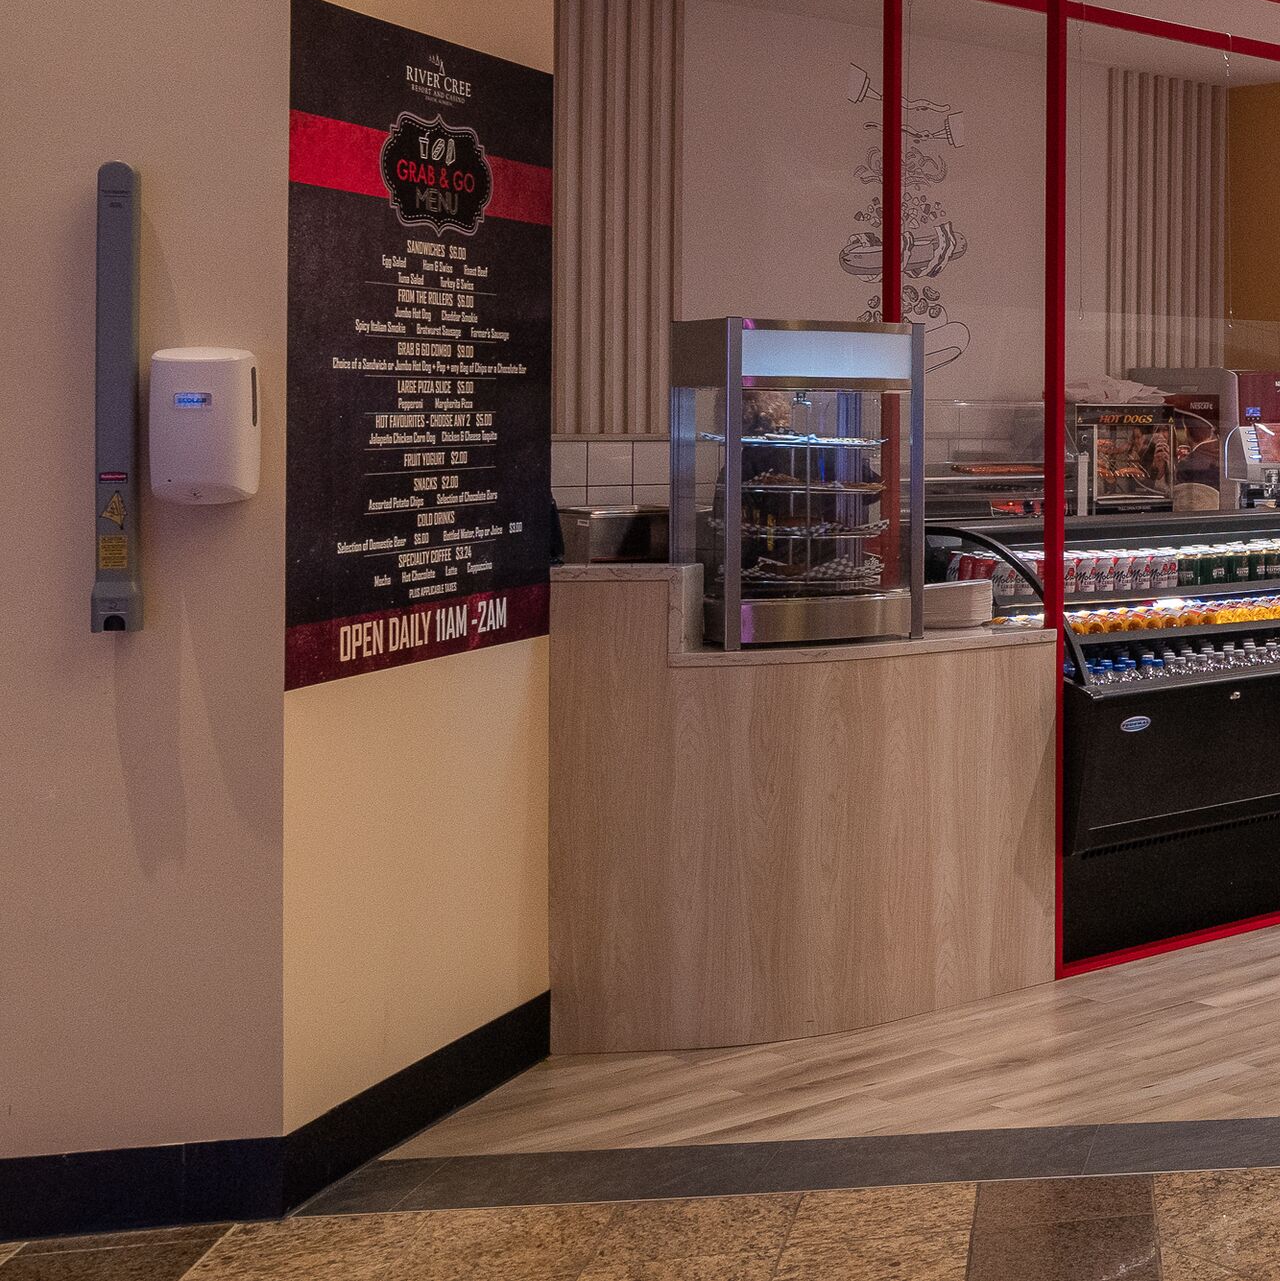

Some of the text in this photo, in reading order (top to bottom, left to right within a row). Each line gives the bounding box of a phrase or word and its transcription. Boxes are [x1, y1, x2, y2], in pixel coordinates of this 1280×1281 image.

[406, 65, 472, 98] RIVER CREE
[396, 158, 475, 193] GRAB & GO
[415, 187, 458, 215] MENU
[406, 240, 446, 258] SANDWICHES
[382, 254, 392, 269] Egg
[392, 255, 407, 268] Salad
[423, 259, 434, 271] Ham
[439, 261, 453, 274] Swiss
[398, 272, 410, 284] Tuna
[410, 273, 425, 286] Salad
[440, 276, 455, 291] Turkey
[460, 279, 474, 291] Swiss
[397, 288, 415, 303] FROM
[416, 290, 428, 305] THE
[428, 291, 454, 307] ROLLERS
[394, 306, 411, 318] Jumbo
[412, 307, 421, 319] Hot
[421, 308, 432, 322] Dog
[441, 310, 461, 322] Cheddar
[355, 318, 510, 341] Spicy Italian Smokie Bratwurst Sausage Farmer's Sausage
[397, 342, 414, 356] GRAB
[421, 343, 430, 356] GO
[430, 343, 452, 358] COMBO
[332, 357, 351, 369] Choice
[351, 357, 358, 369] of
[362, 358, 387, 370] Sandwich
[387, 362, 394, 370] or
[394, 359, 412, 371] Jumbo
[412, 360, 421, 371] Hot
[421, 360, 432, 373] Dog
[436, 361, 446, 374] Pop
[474, 362, 488, 375] Chips
[397, 380, 417, 394] LARGE
[417, 380, 435, 394] PIZZA
[435, 381, 451, 394] SLICE
[397, 397, 473, 411] Pepperoni Margherita Pizza
[375, 414, 389, 429] HOT
[389, 414, 425, 428] FAVOURITES
[430, 414, 453, 427] CHOOSE
[453, 414, 466, 427] ANY
[466, 414, 471, 427] 2
[1100, 414, 1154, 424] HOT DOGS
[393, 432, 413, 444] Chicken
[413, 431, 426, 443] Corn
[426, 431, 436, 445] Dog
[441, 431, 460, 442] Chicken
[464, 430, 481, 442] Cheese
[403, 451, 468, 467] FRUIT YOGURT $2.00
[413, 475, 459, 492] SNACKS $2.00
[368, 489, 498, 511] Assorted Potato Chips Selection of Chocolate Bars
[417, 510, 456, 527] COLD DRINKS
[337, 541, 362, 555] Selection
[362, 539, 369, 551] of
[368, 537, 393, 551] Domestic
[393, 535, 407, 548] Beer
[443, 529, 460, 542] Bottled
[475, 526, 484, 539] Pop
[484, 528, 491, 536] or
[490, 524, 503, 536] Juice
[398, 545, 473, 568] SPECIALTY COFFEE $3.24
[374, 574, 392, 588] Mocha
[401, 571, 411, 583] Hot
[411, 568, 436, 582] Chocolate
[444, 565, 458, 577] Latte
[408, 588, 421, 599] PLUS
[420, 584, 445, 597] APPLICABLE
[339, 619, 384, 663] OPEN
[388, 610, 432, 652] DAILY
[435, 604, 468, 643] 11AM
